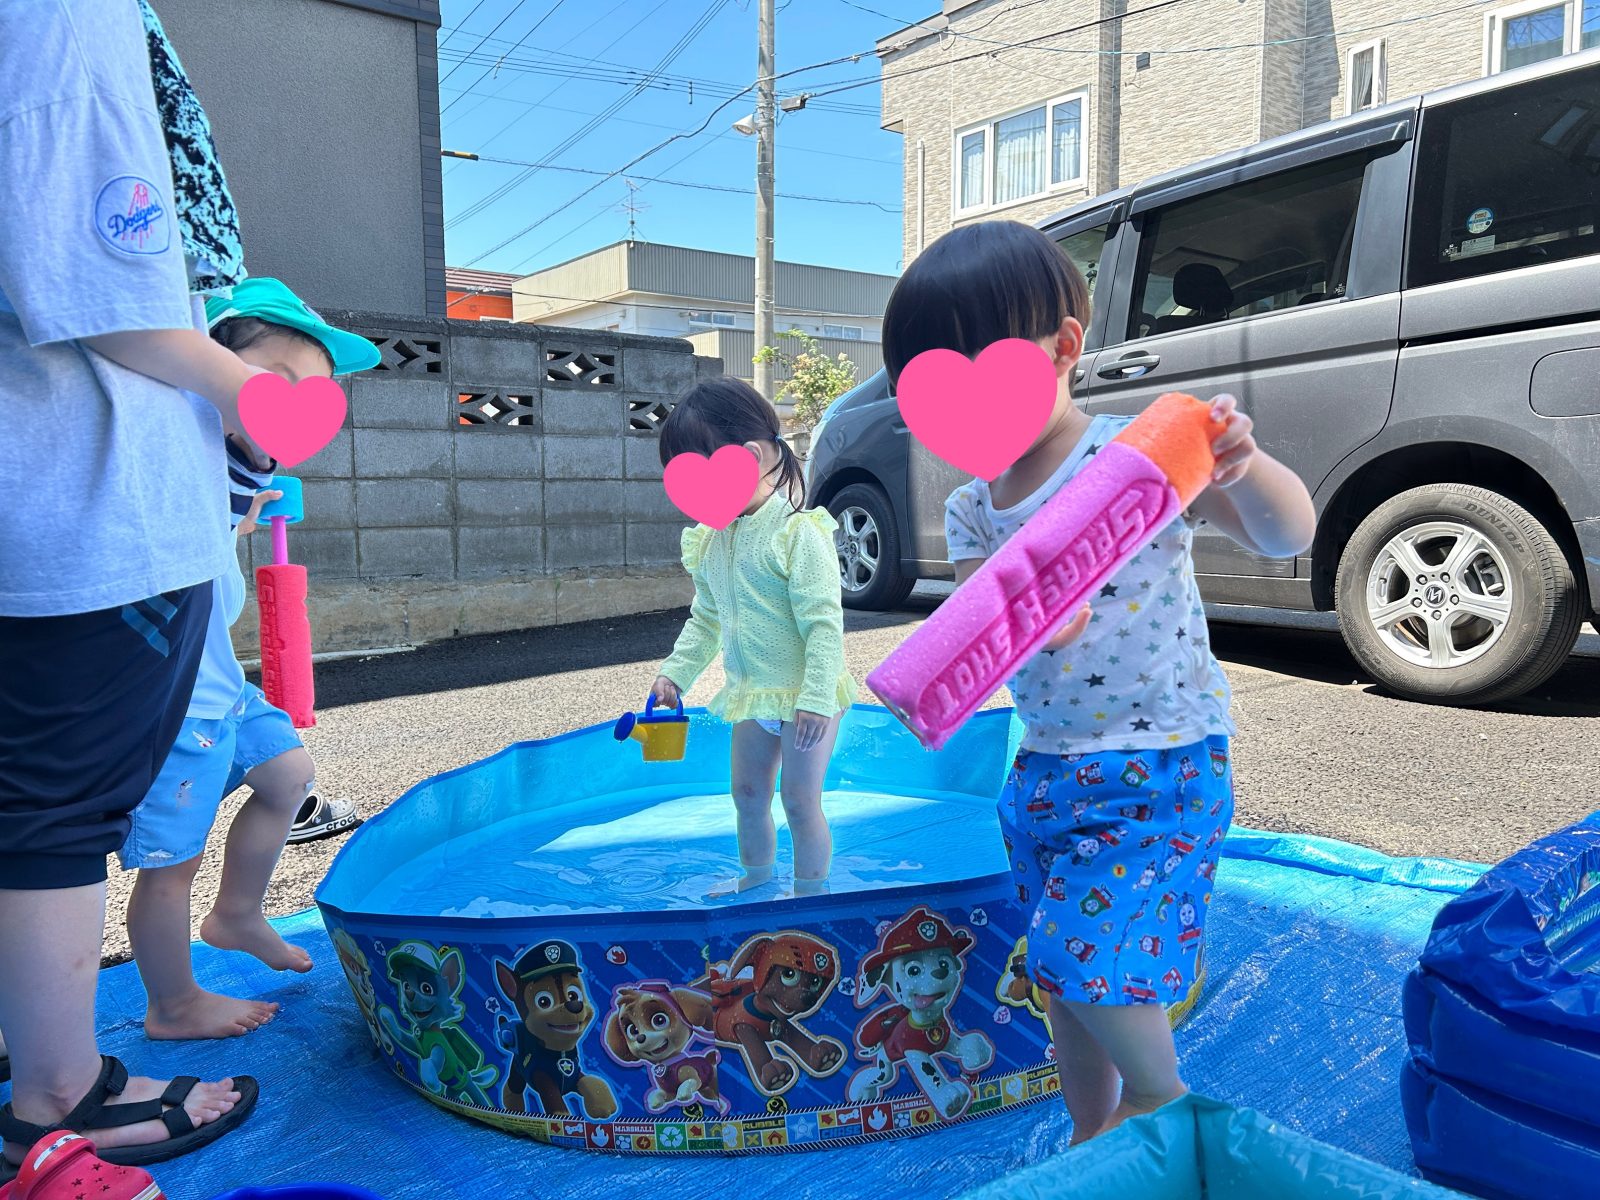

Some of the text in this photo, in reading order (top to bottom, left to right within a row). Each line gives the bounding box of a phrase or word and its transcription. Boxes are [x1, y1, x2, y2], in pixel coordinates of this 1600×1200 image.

[107, 200, 164, 238] Dodgers
[1462, 502, 1525, 553] DUNLOP
[934, 487, 1147, 717] SPLASH SHOT
[325, 812, 357, 831] crocs
[893, 1098, 929, 1111] MARSHAL
[614, 1125, 654, 1133] MARSHALL
[742, 1119, 785, 1130] RUBBLE
[821, 1125, 861, 1139] CHASE
[689, 1139, 723, 1149] ROCK
